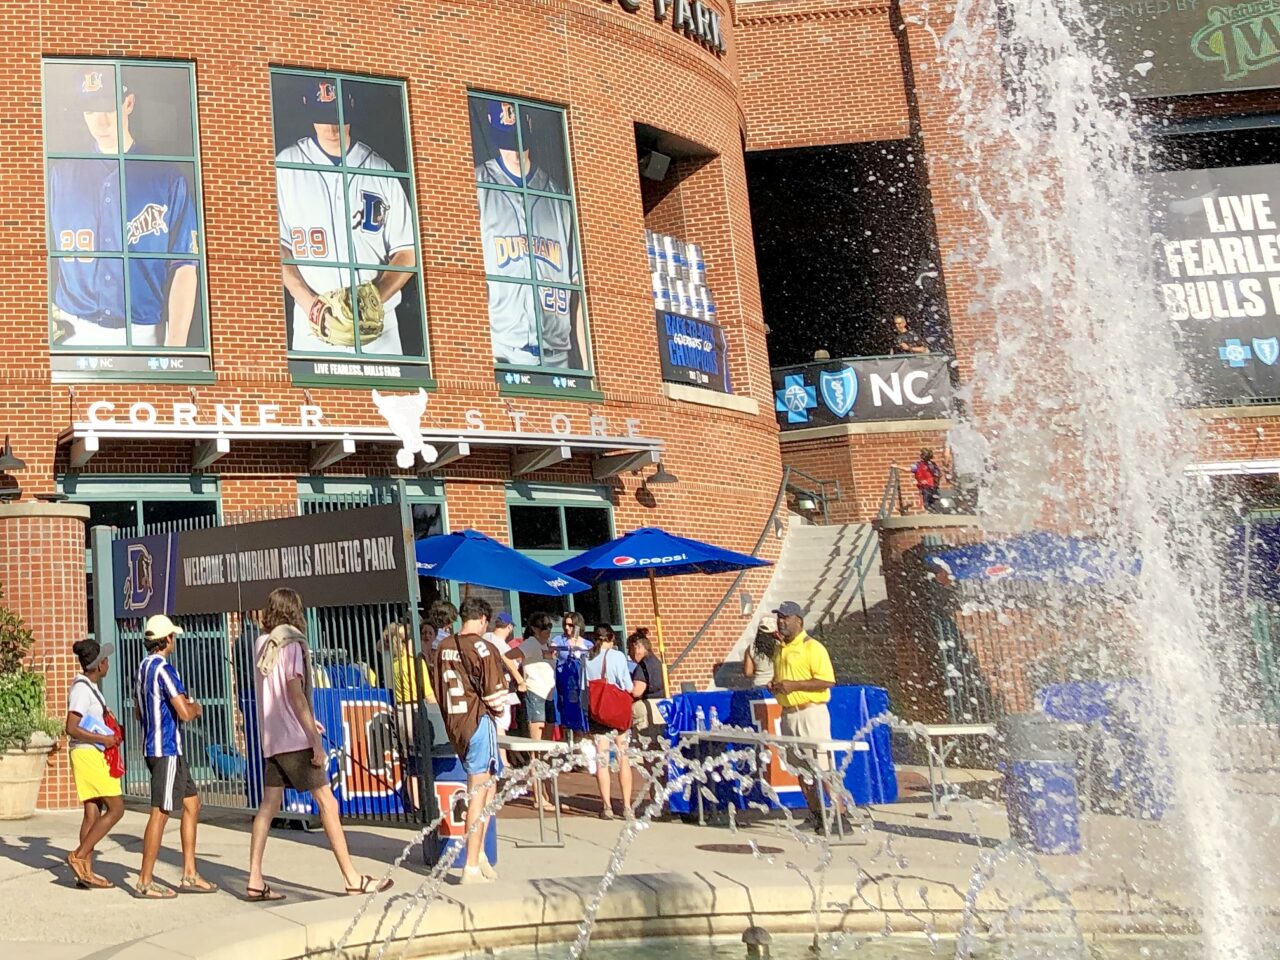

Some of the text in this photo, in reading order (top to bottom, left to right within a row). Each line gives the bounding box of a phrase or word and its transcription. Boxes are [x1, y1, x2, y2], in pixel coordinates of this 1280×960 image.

[1203, 193, 1277, 233] LIVE
[292, 227, 329, 258] 29
[542, 278, 569, 316] 29
[1162, 278, 1267, 321] BULLS
[99, 358, 114, 368] NC
[170, 359, 184, 369] NC
[314, 362, 329, 375] LIVE
[521, 375, 532, 385] NC
[567, 379, 577, 388] NC
[870, 371, 933, 407] NC
[87, 400, 641, 439] CORNER STORE
[183, 535, 396, 587] WELCOME TO DURHAM BULLS ATHLETIC PARK
[639, 553, 688, 565] pepsi
[473, 640, 491, 658] 2
[442, 669, 469, 715] 2
